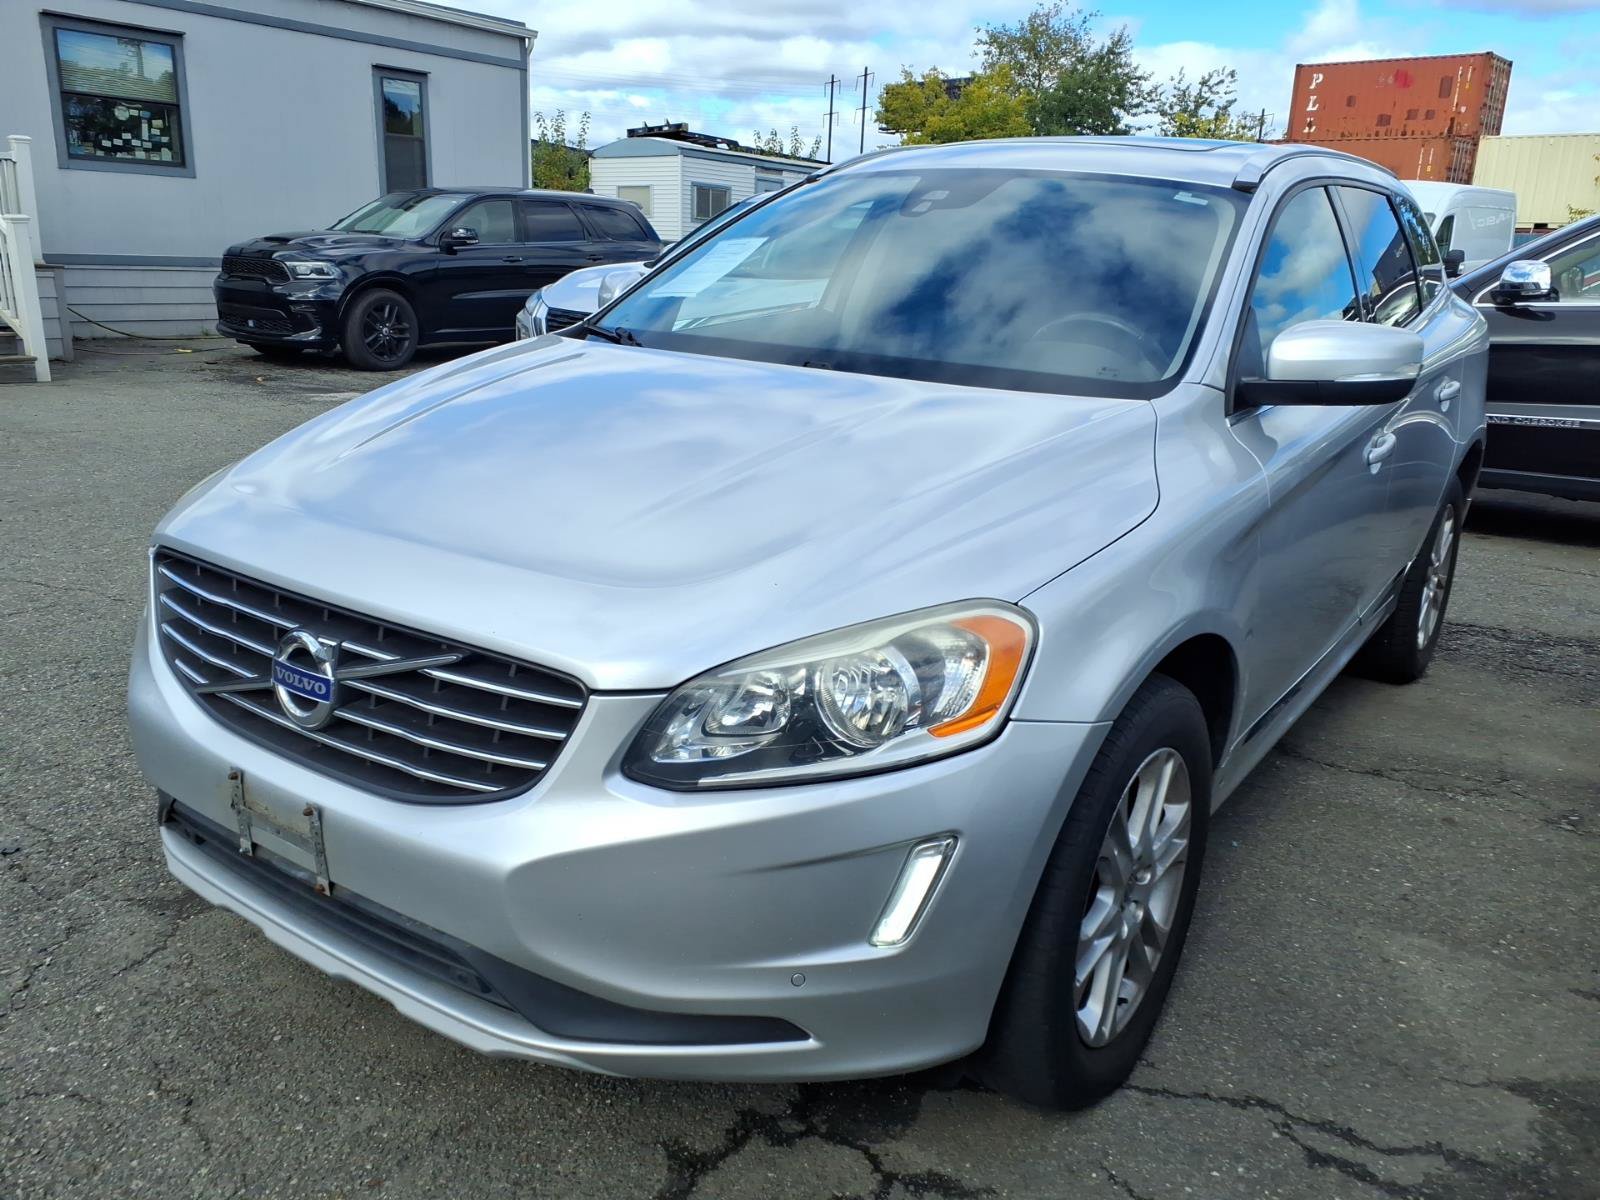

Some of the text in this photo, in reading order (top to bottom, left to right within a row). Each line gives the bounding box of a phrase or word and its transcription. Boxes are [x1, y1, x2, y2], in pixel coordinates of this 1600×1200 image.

[1486, 416, 1580, 428] AND CHEROKEE
[275, 665, 327, 695] VOLVO
